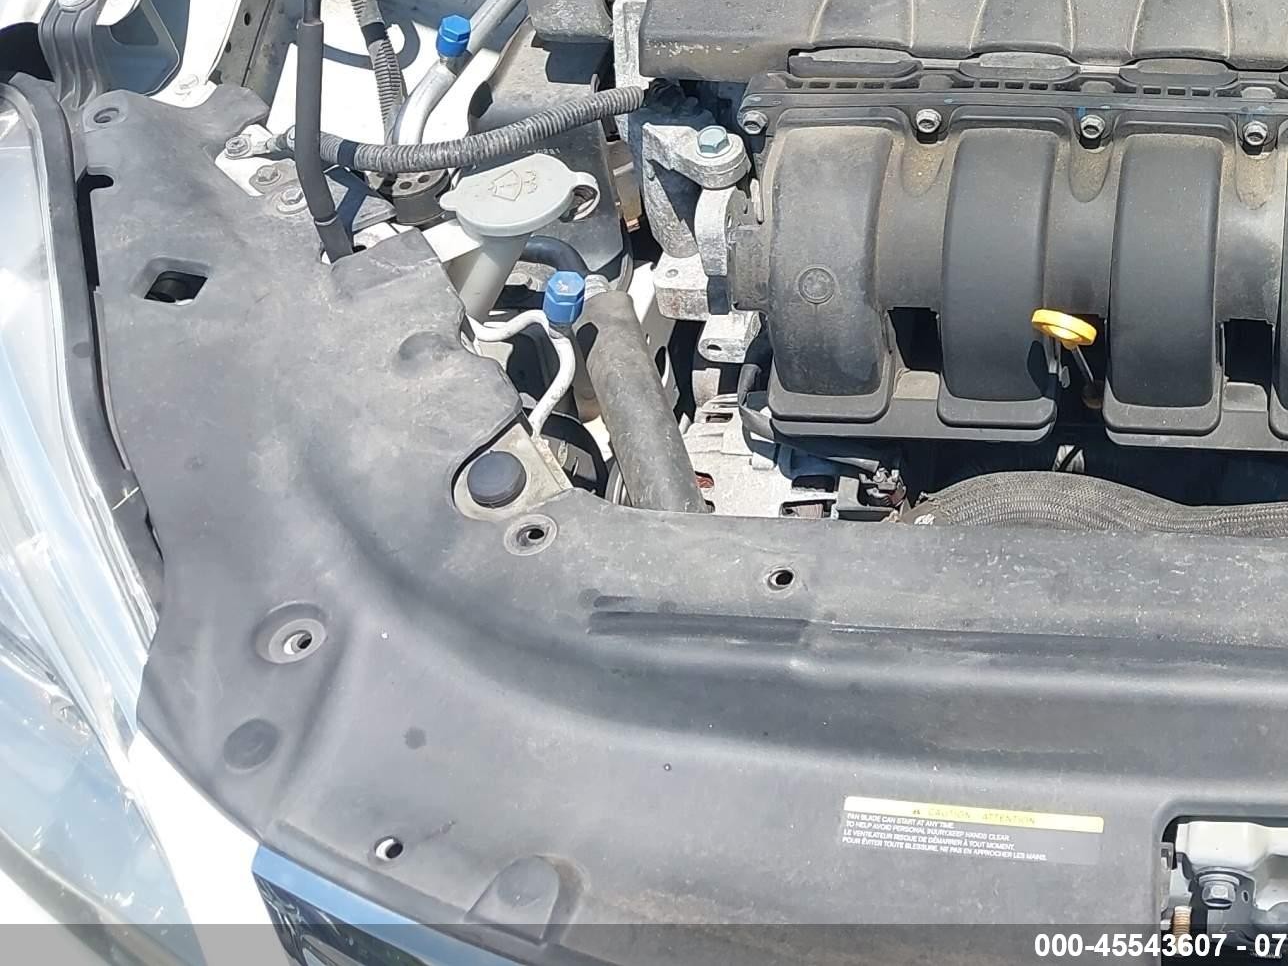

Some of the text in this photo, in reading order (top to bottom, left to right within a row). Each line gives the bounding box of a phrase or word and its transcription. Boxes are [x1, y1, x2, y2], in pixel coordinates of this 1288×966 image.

[882, 816, 895, 824] CAN
[928, 808, 1036, 825] CAUTION ATTENTION
